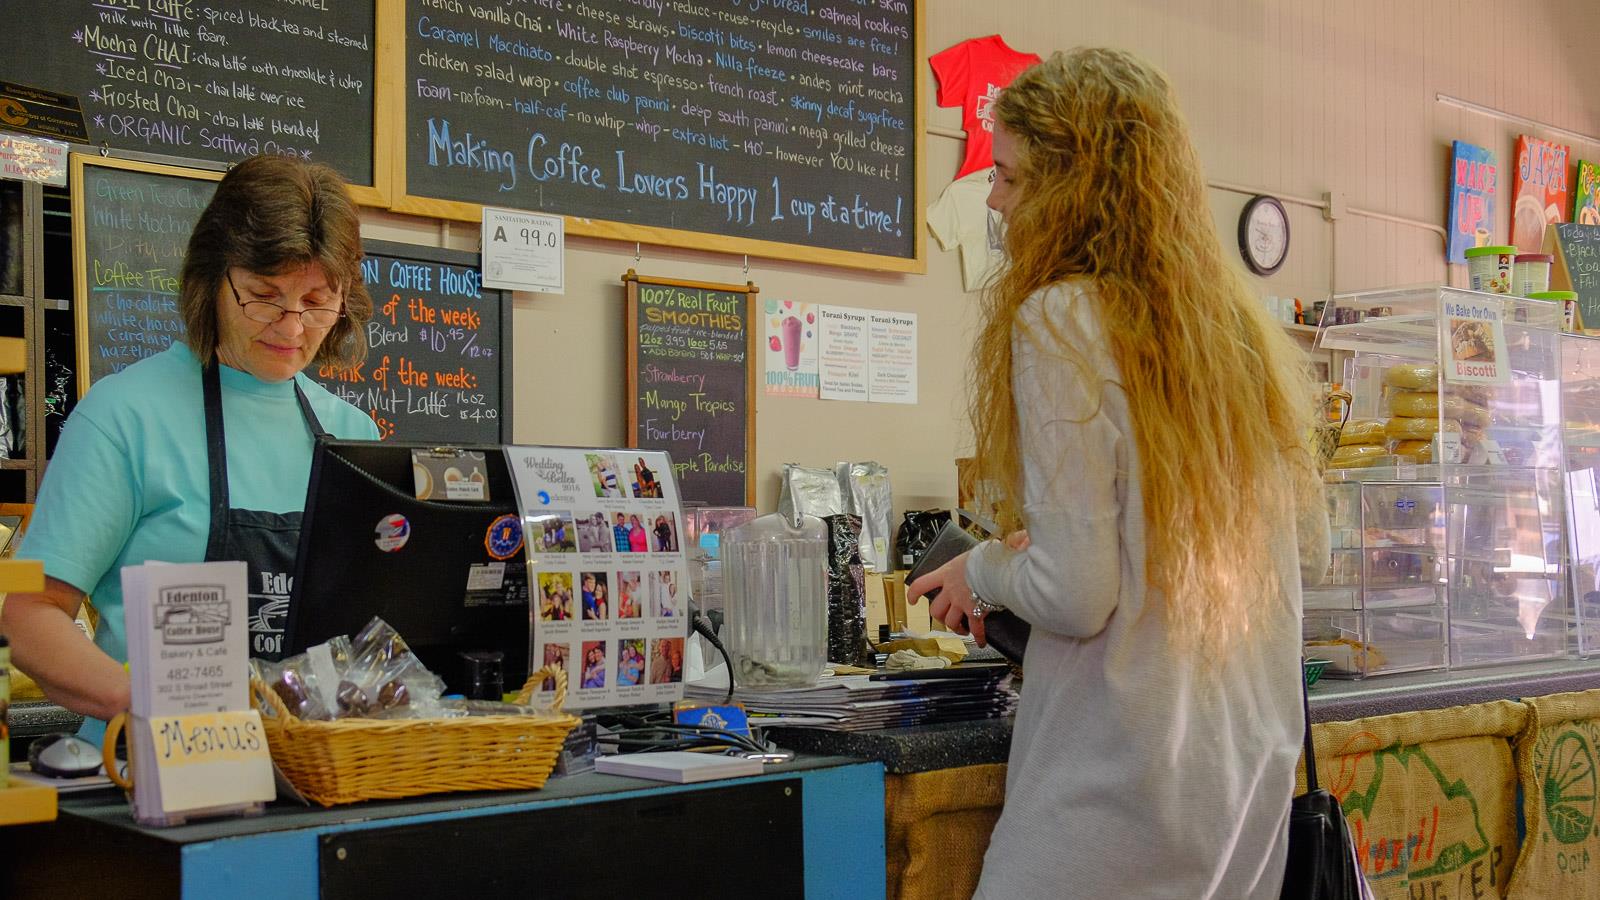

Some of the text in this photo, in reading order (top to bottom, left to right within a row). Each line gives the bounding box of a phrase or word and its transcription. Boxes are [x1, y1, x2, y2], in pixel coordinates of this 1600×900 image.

[100, 10, 127, 25] milk
[131, 17, 157, 31] with
[164, 22, 190, 39] little
[203, 7, 369, 51] spiced black tea and steamed
[819, 7, 861, 30] oatmeal
[864, 18, 909, 39] cookies
[468, 4, 511, 25] vanilla
[514, 11, 542, 33] Chai
[556, 18, 599, 44] White
[604, 29, 660, 66] Raspberry
[665, 45, 703, 66] Mocha
[715, 51, 743, 73] Nilla
[745, 58, 787, 81] freeze
[799, 73, 831, 92] andes
[838, 81, 865, 98] mint
[867, 85, 904, 104] mocha
[576, 2, 620, 24] cheese
[625, 14, 669, 38] straws
[678, 21, 724, 45] biscotti
[730, 32, 756, 52] bites
[766, 40, 797, 58] lemon
[801, 50, 866, 72] cheesecake
[872, 58, 898, 80] bars
[802, 26, 898, 55] smiles are free!
[84, 24, 137, 54] Mocha
[252, 61, 279, 77] with
[281, 66, 328, 85] chocolate
[338, 74, 363, 94] whip
[418, 16, 480, 48] Caramel
[489, 34, 552, 61] Macchiato
[564, 49, 607, 73] double
[612, 61, 639, 80] shot
[643, 71, 697, 91] espresso
[707, 74, 744, 99] french
[748, 86, 780, 106] roast
[790, 95, 823, 122] skinny
[826, 100, 856, 121] decaf
[105, 58, 148, 84] Iced
[205, 80, 230, 98] chai
[260, 90, 285, 106] over
[286, 95, 306, 109] ice
[101, 84, 160, 114] Frosted
[271, 119, 320, 144] blended
[418, 49, 905, 157] chicken salad wrap coffee club panini deep south panini mega grilled cheese
[109, 113, 192, 146] ORGANIC
[417, 78, 451, 100] Foam
[577, 110, 591, 123] no
[594, 113, 625, 137] whip
[635, 119, 661, 142] whip
[672, 126, 706, 146] extra
[709, 131, 729, 151] hot
[775, 146, 824, 168] however
[829, 152, 854, 172] YOU
[857, 160, 877, 177] like
[426, 116, 518, 193] Making
[527, 132, 606, 189] Coffee
[615, 149, 689, 200] Lovers
[696, 161, 758, 227] Happy
[770, 175, 785, 222] 1
[790, 196, 816, 237] cup
[852, 191, 902, 238] time!
[1455, 158, 1497, 194] WAKE
[1520, 143, 1567, 192] JAVA
[495, 215, 530, 225] SANITATION
[493, 225, 556, 248] A 99.0
[94, 259, 144, 289] Coffee
[389, 260, 432, 291] COFFEE
[440, 267, 482, 299] HOUSE
[383, 294, 400, 326] of
[408, 298, 436, 325] the
[641, 287, 676, 307] 100%
[678, 289, 702, 311] Real
[1445, 302, 1497, 320] We Bake Our Own
[645, 306, 742, 331] SMOOTHIES
[822, 310, 866, 322] Torani Syrups
[871, 315, 914, 327] Torani Syrups
[367, 322, 408, 349] Blend
[373, 355, 390, 391] of
[398, 356, 428, 388] the
[766, 370, 793, 386] 100%
[1455, 361, 1497, 378] Biscotti
[646, 389, 735, 420] Mango Tropics
[523, 456, 564, 474] Wedding
[699, 452, 745, 473] Paradise
[167, 590, 219, 604] Edenton
[166, 625, 220, 636] Coffee House
[161, 650, 193, 660] Bakery
[160, 720, 261, 759] Menus
